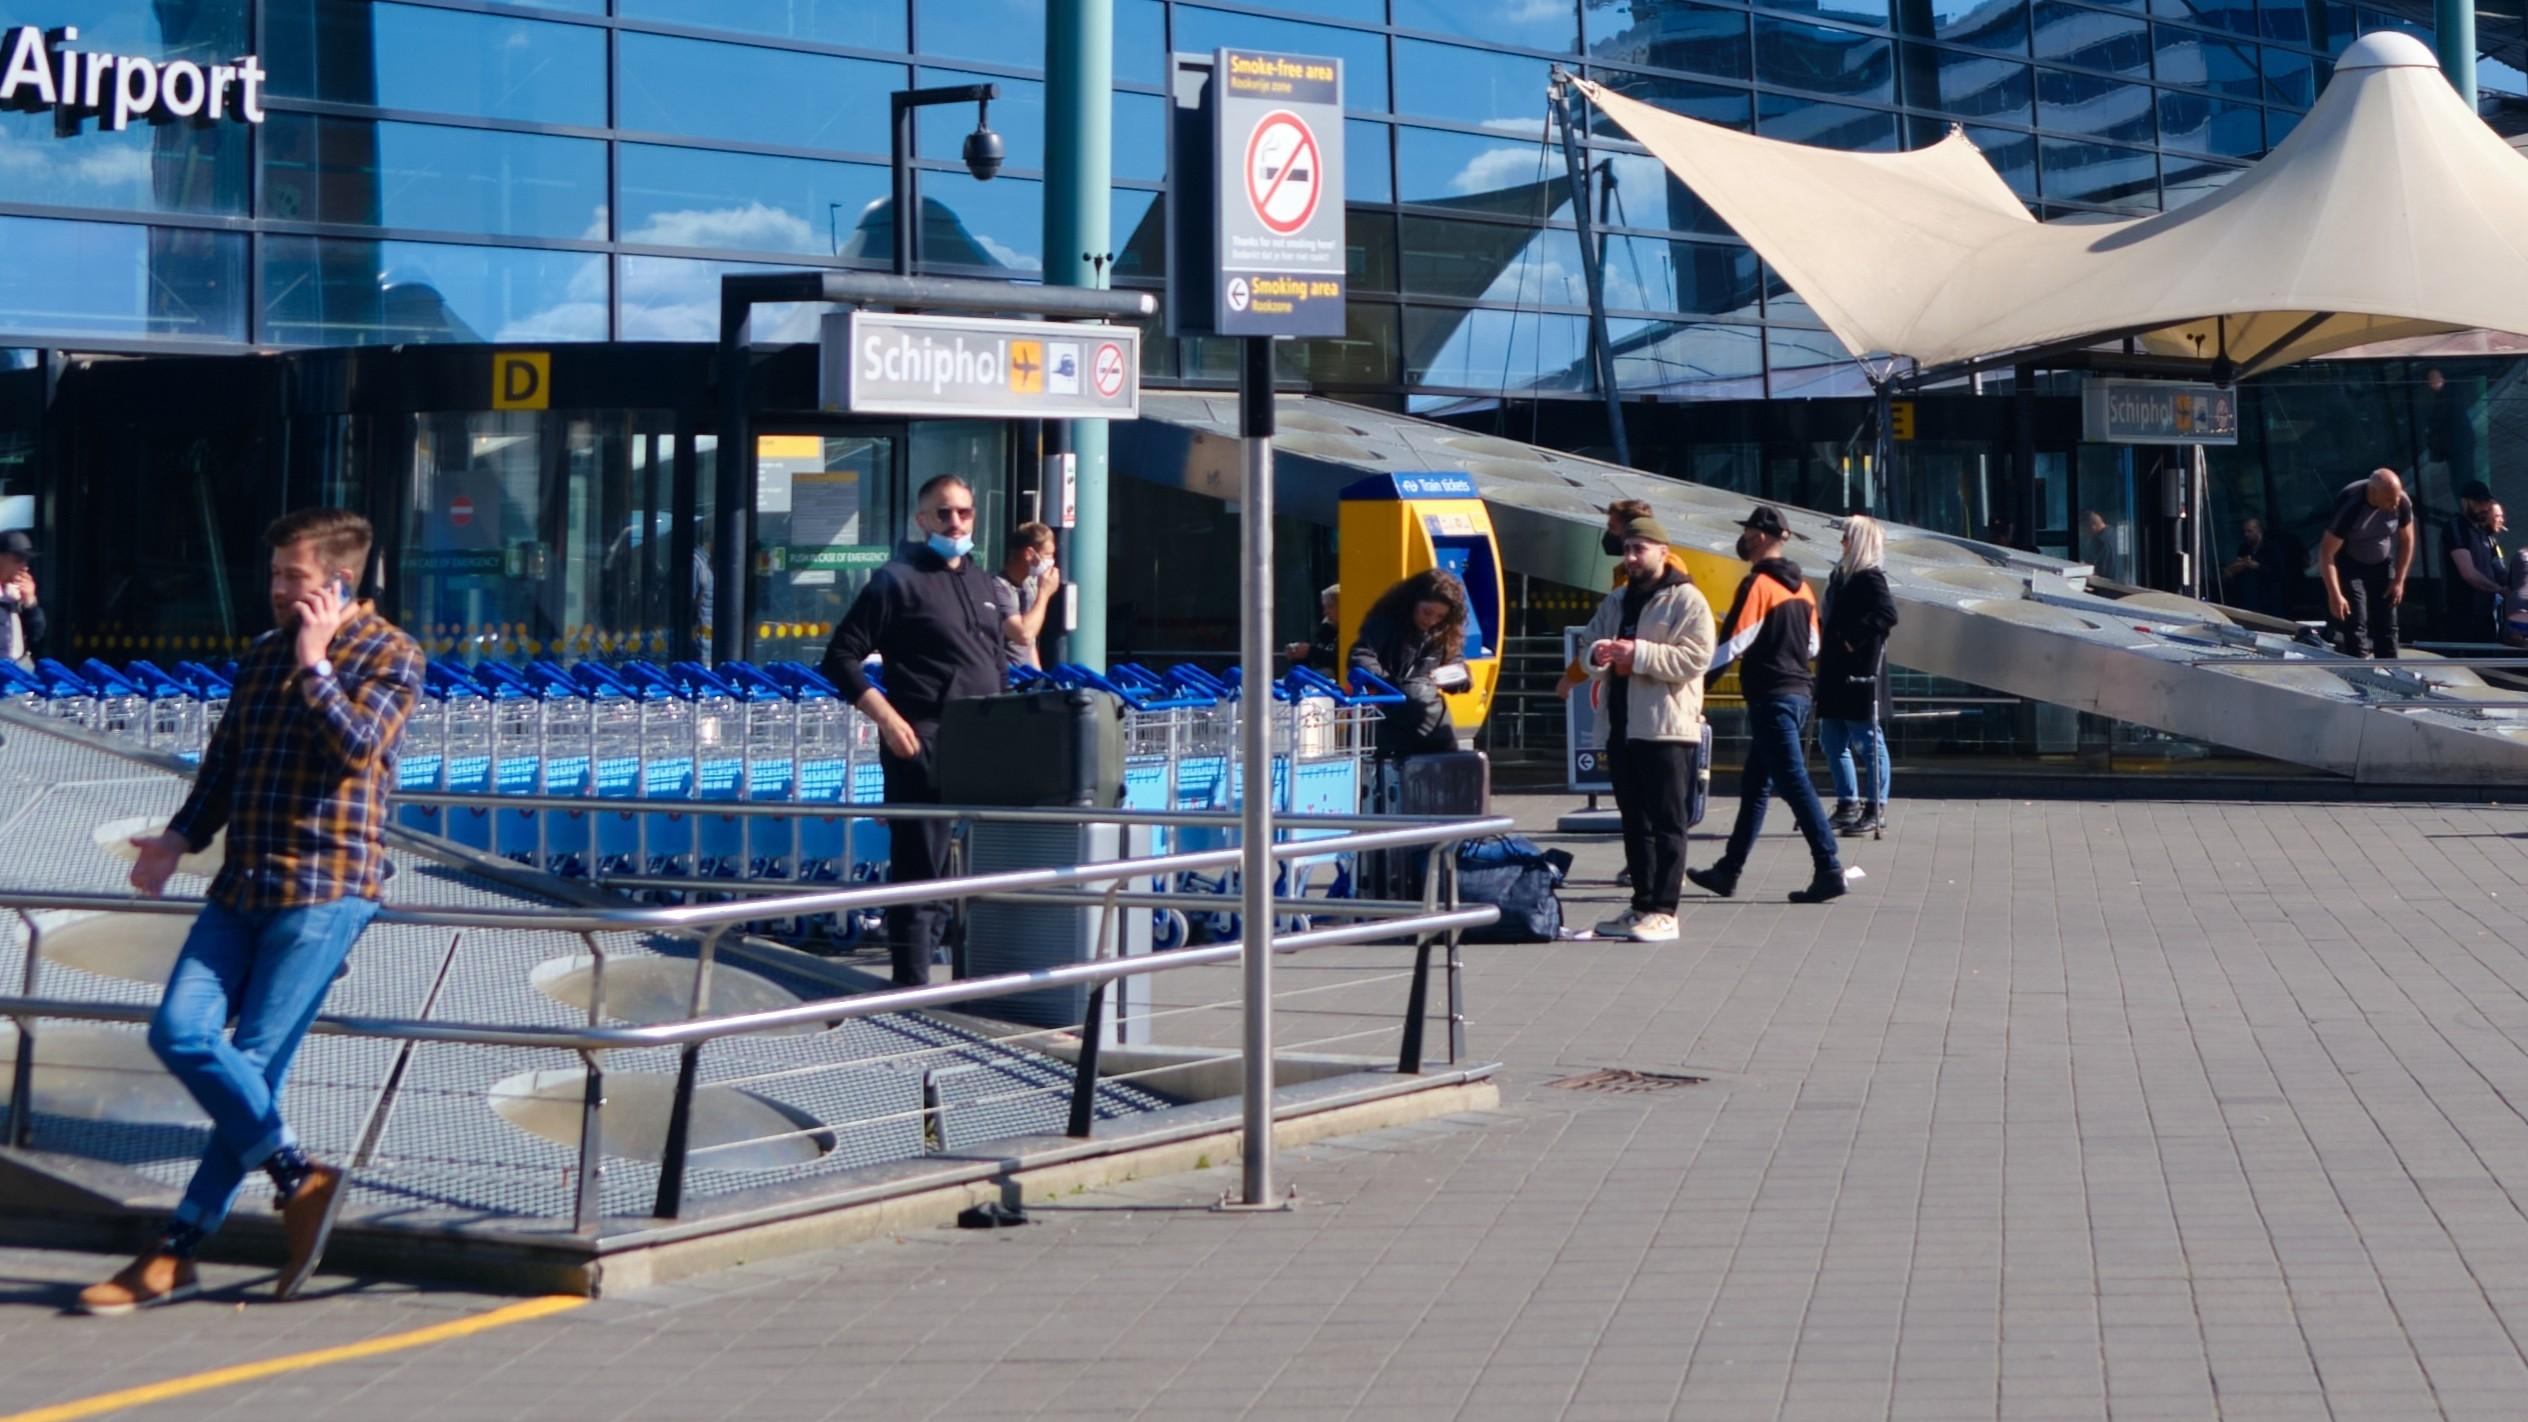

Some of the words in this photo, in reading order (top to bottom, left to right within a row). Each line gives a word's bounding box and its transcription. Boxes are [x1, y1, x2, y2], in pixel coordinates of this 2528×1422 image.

[0, 26, 266, 130] Airport
[1231, 54, 1304, 78] Smoke-free
[1305, 65, 1334, 81] area
[1252, 276, 1308, 301] Smoking
[1310, 281, 1339, 297] area
[504, 360, 539, 401] D
[864, 334, 1005, 395] Schiphol
[2110, 394, 2174, 431] Schiphol
[1418, 478, 1442, 492] Train
[1441, 478, 1471, 492] tickets
